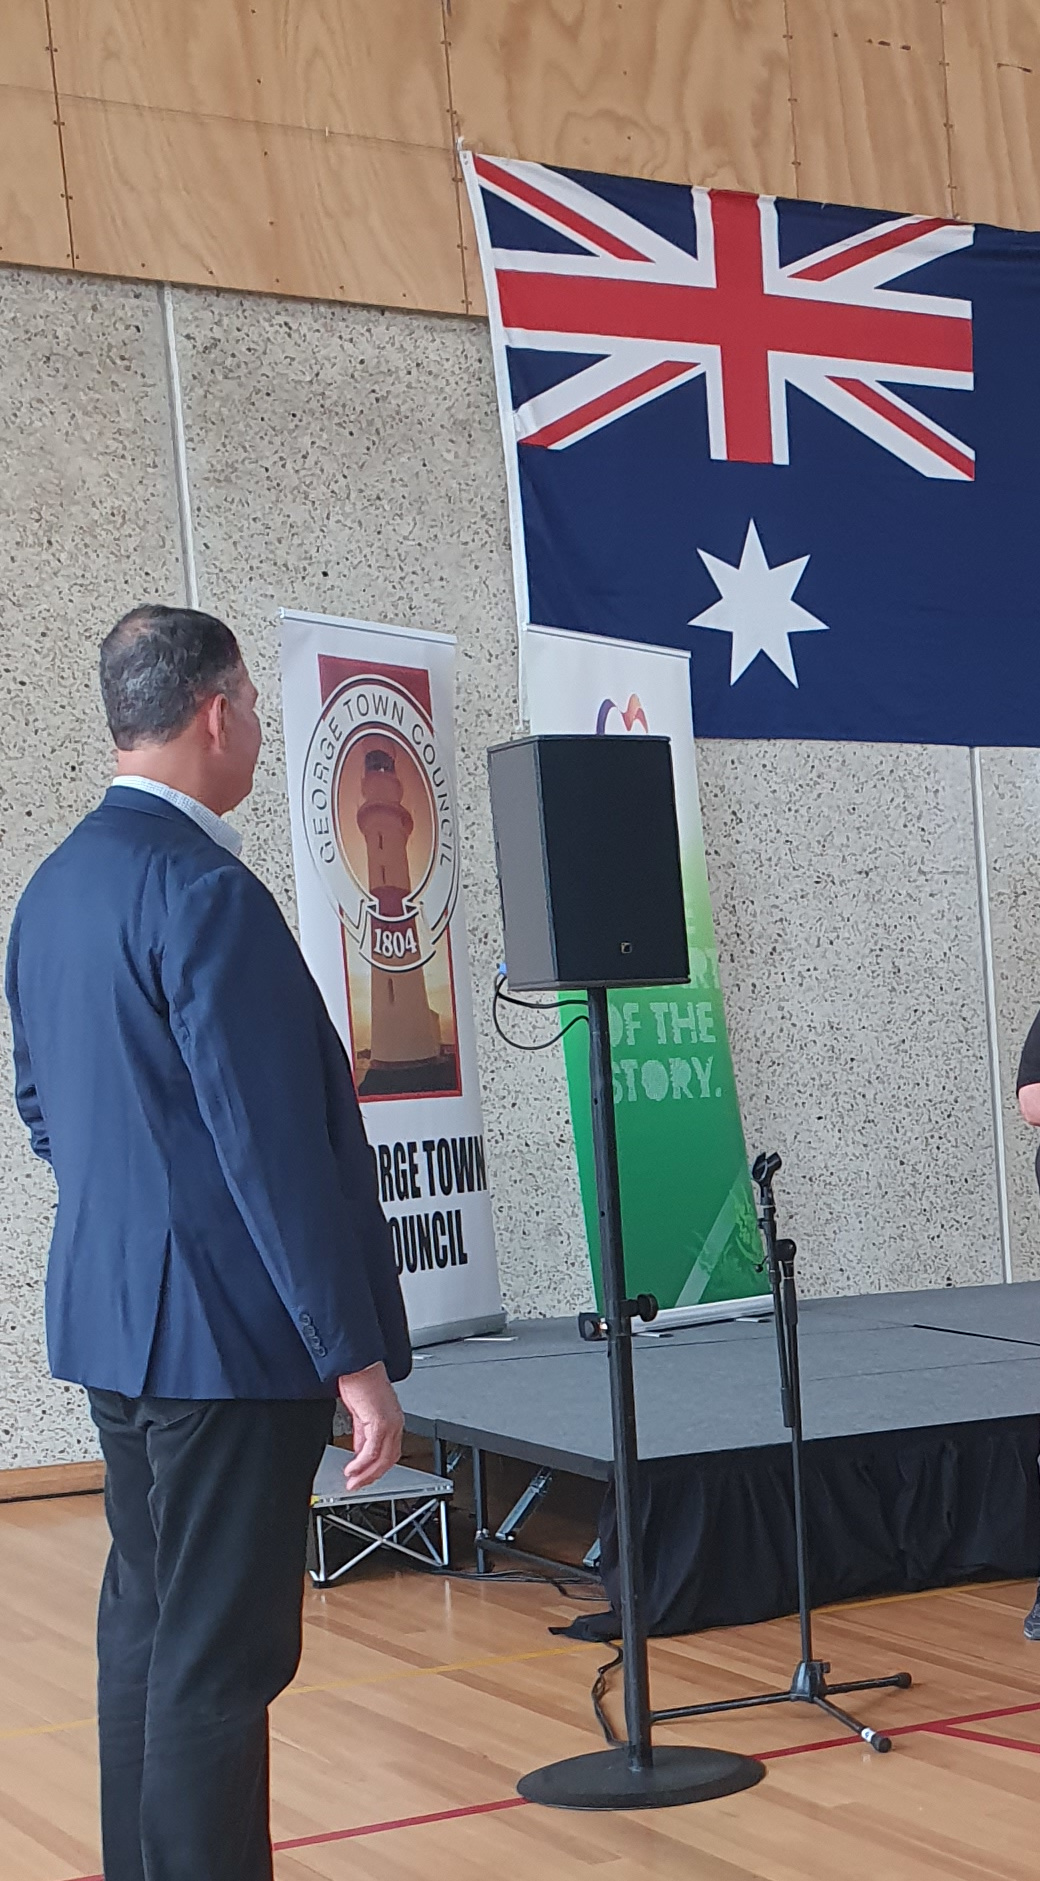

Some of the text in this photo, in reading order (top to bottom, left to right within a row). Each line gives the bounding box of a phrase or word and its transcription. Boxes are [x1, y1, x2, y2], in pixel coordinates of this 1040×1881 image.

[312, 692, 454, 867] GEORGE TOWN COUNCIL
[373, 928, 418, 959] 1804
[650, 1001, 717, 1045] THE
[378, 1134, 488, 1202] RGE TOWN
[387, 1209, 469, 1275] OUNCIL
